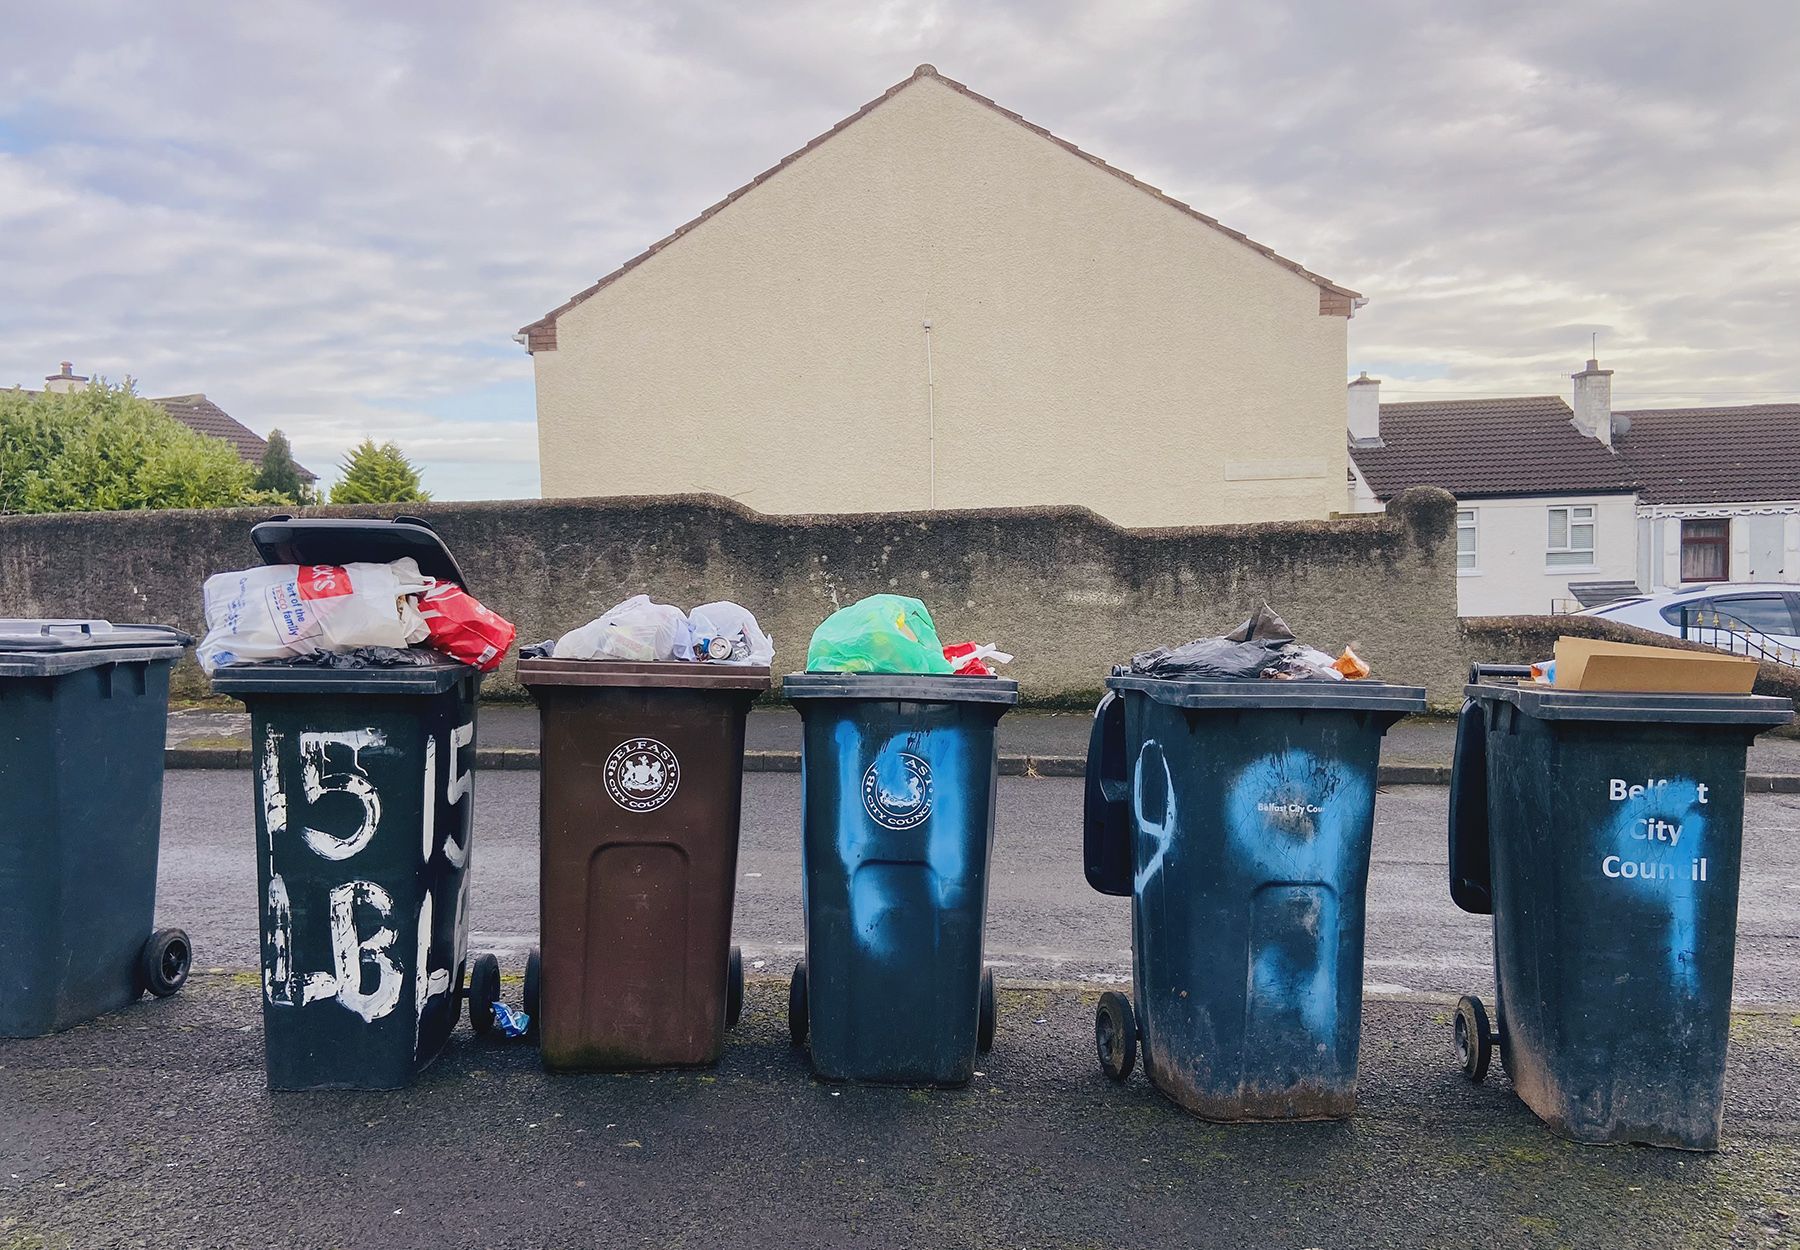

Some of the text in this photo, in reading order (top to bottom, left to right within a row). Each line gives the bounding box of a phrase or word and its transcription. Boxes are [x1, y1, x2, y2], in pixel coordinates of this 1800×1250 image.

[275, 584, 300, 636] TESCO family
[286, 582, 306, 622] Part of the
[608, 740, 677, 772] BELFAST
[608, 778, 676, 809] CITY COUNCIL
[1609, 778, 1709, 804] Belft
[866, 795, 887, 820] CITY
[1257, 802, 1288, 813] Belfast
[1288, 803, 1306, 815] City
[1630, 817, 1684, 847] City
